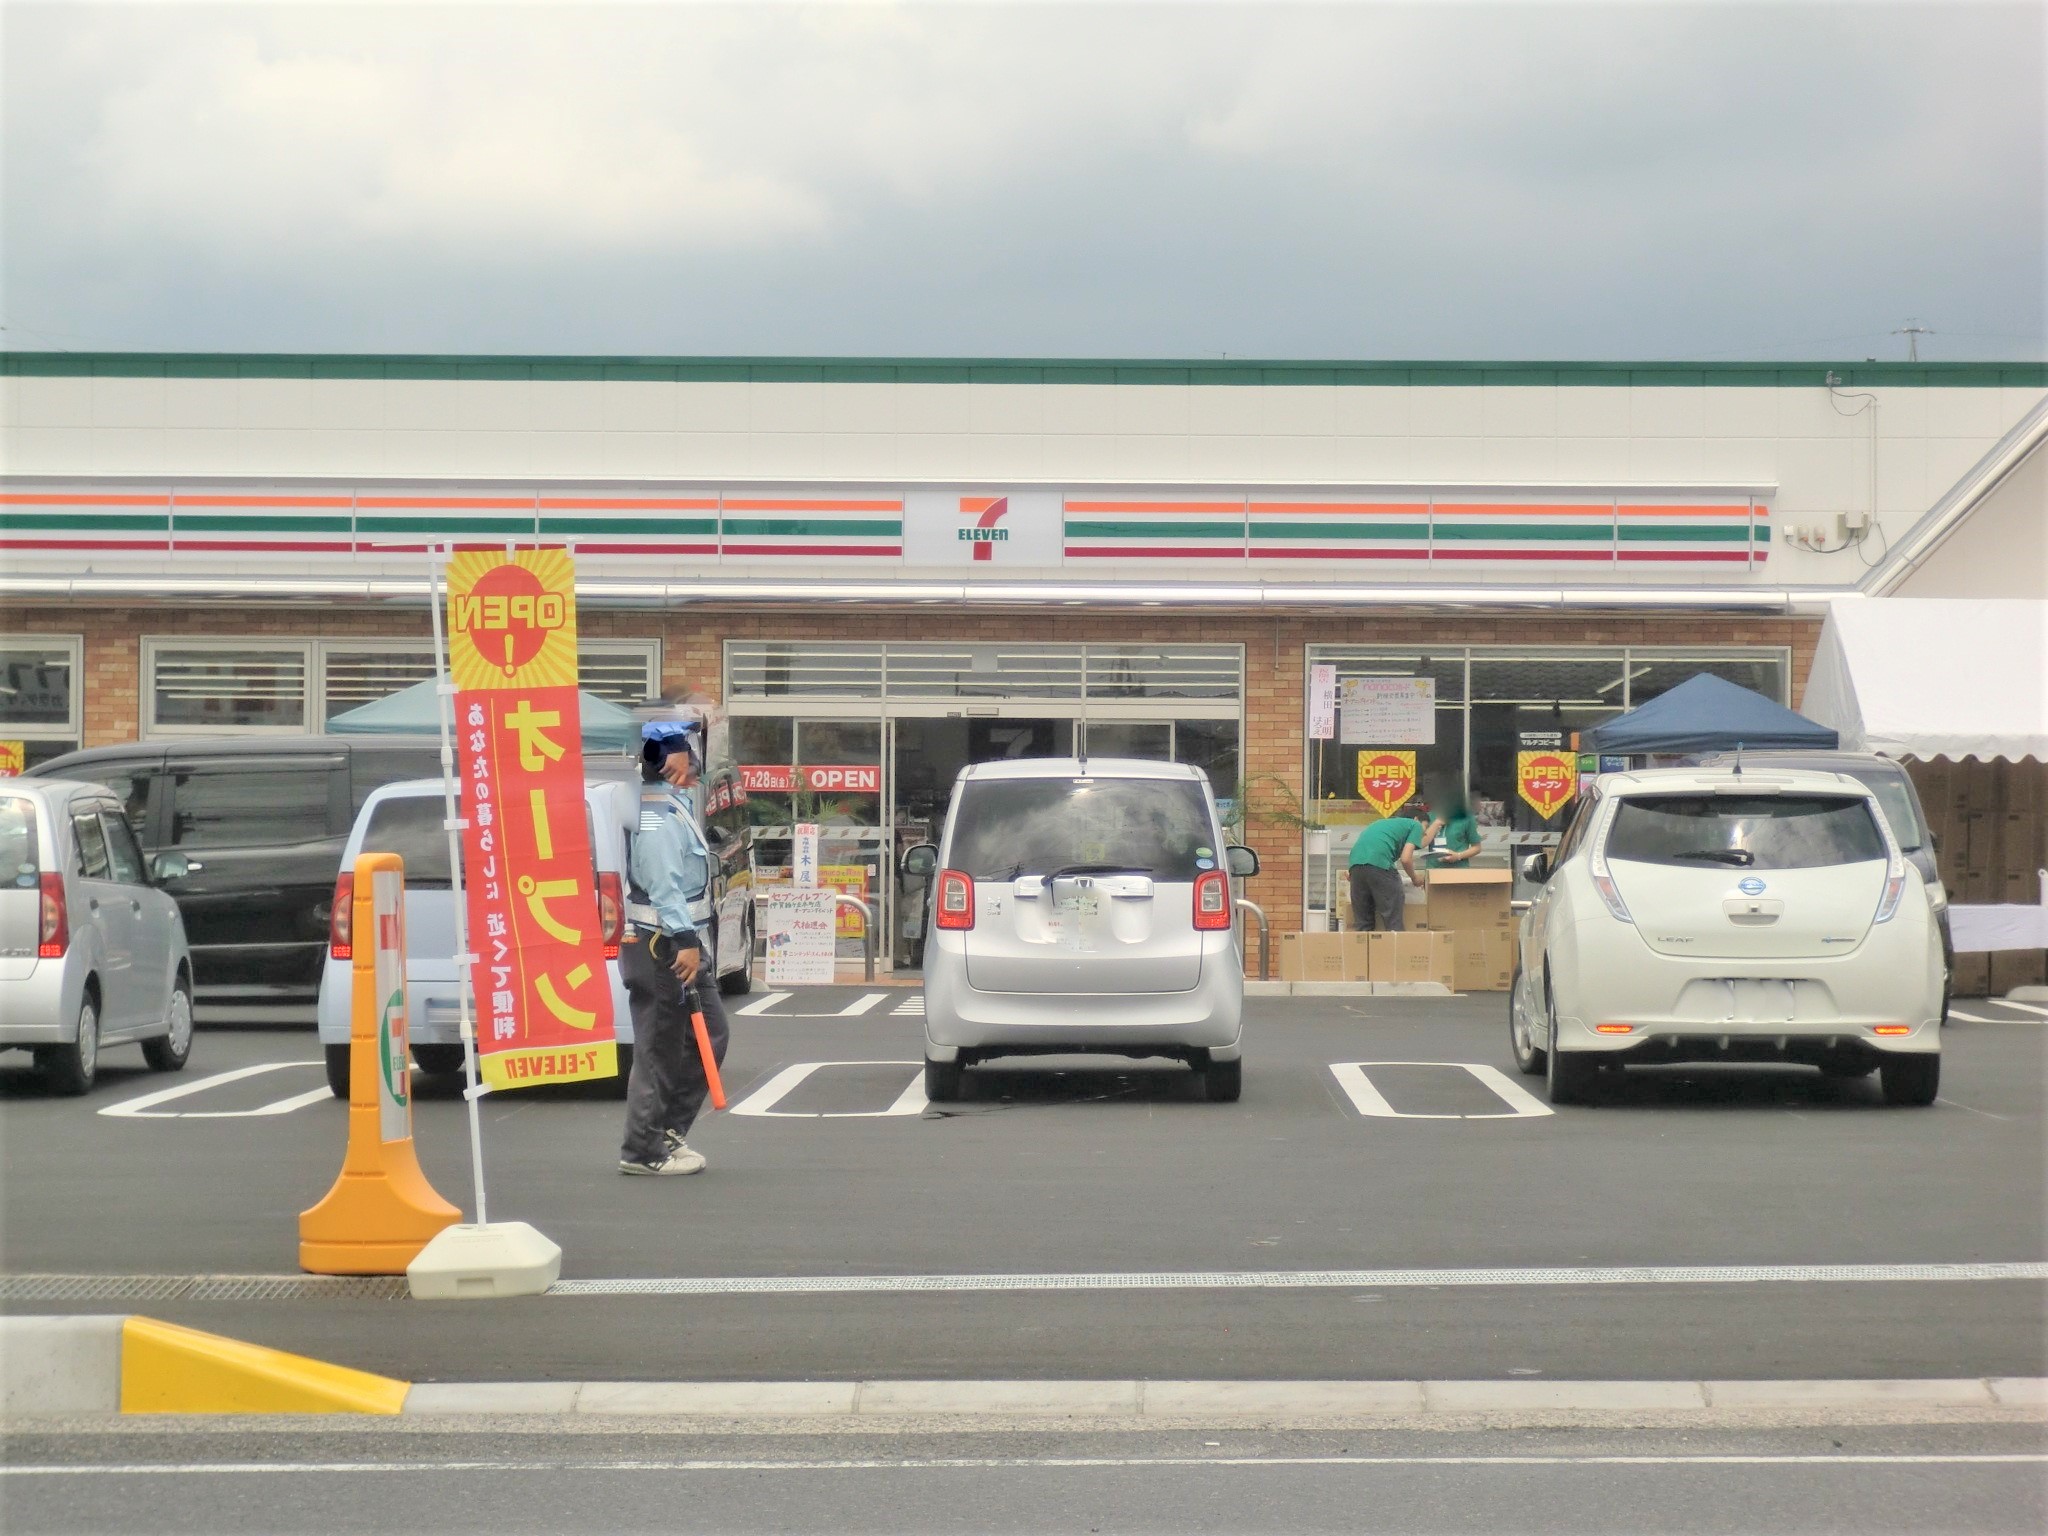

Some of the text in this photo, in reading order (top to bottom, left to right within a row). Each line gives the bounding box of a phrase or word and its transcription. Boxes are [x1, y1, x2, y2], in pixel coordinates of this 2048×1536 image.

[1362, 765, 1413, 779] OPEN
[1521, 766, 1572, 780] OPEN
[811, 770, 875, 788] OPEN
[1372, 780, 1402, 788] オープン
[1532, 781, 1562, 789] オープン
[771, 893, 832, 901] セブンイレブン
[793, 920, 828, 930] 大抽選会
